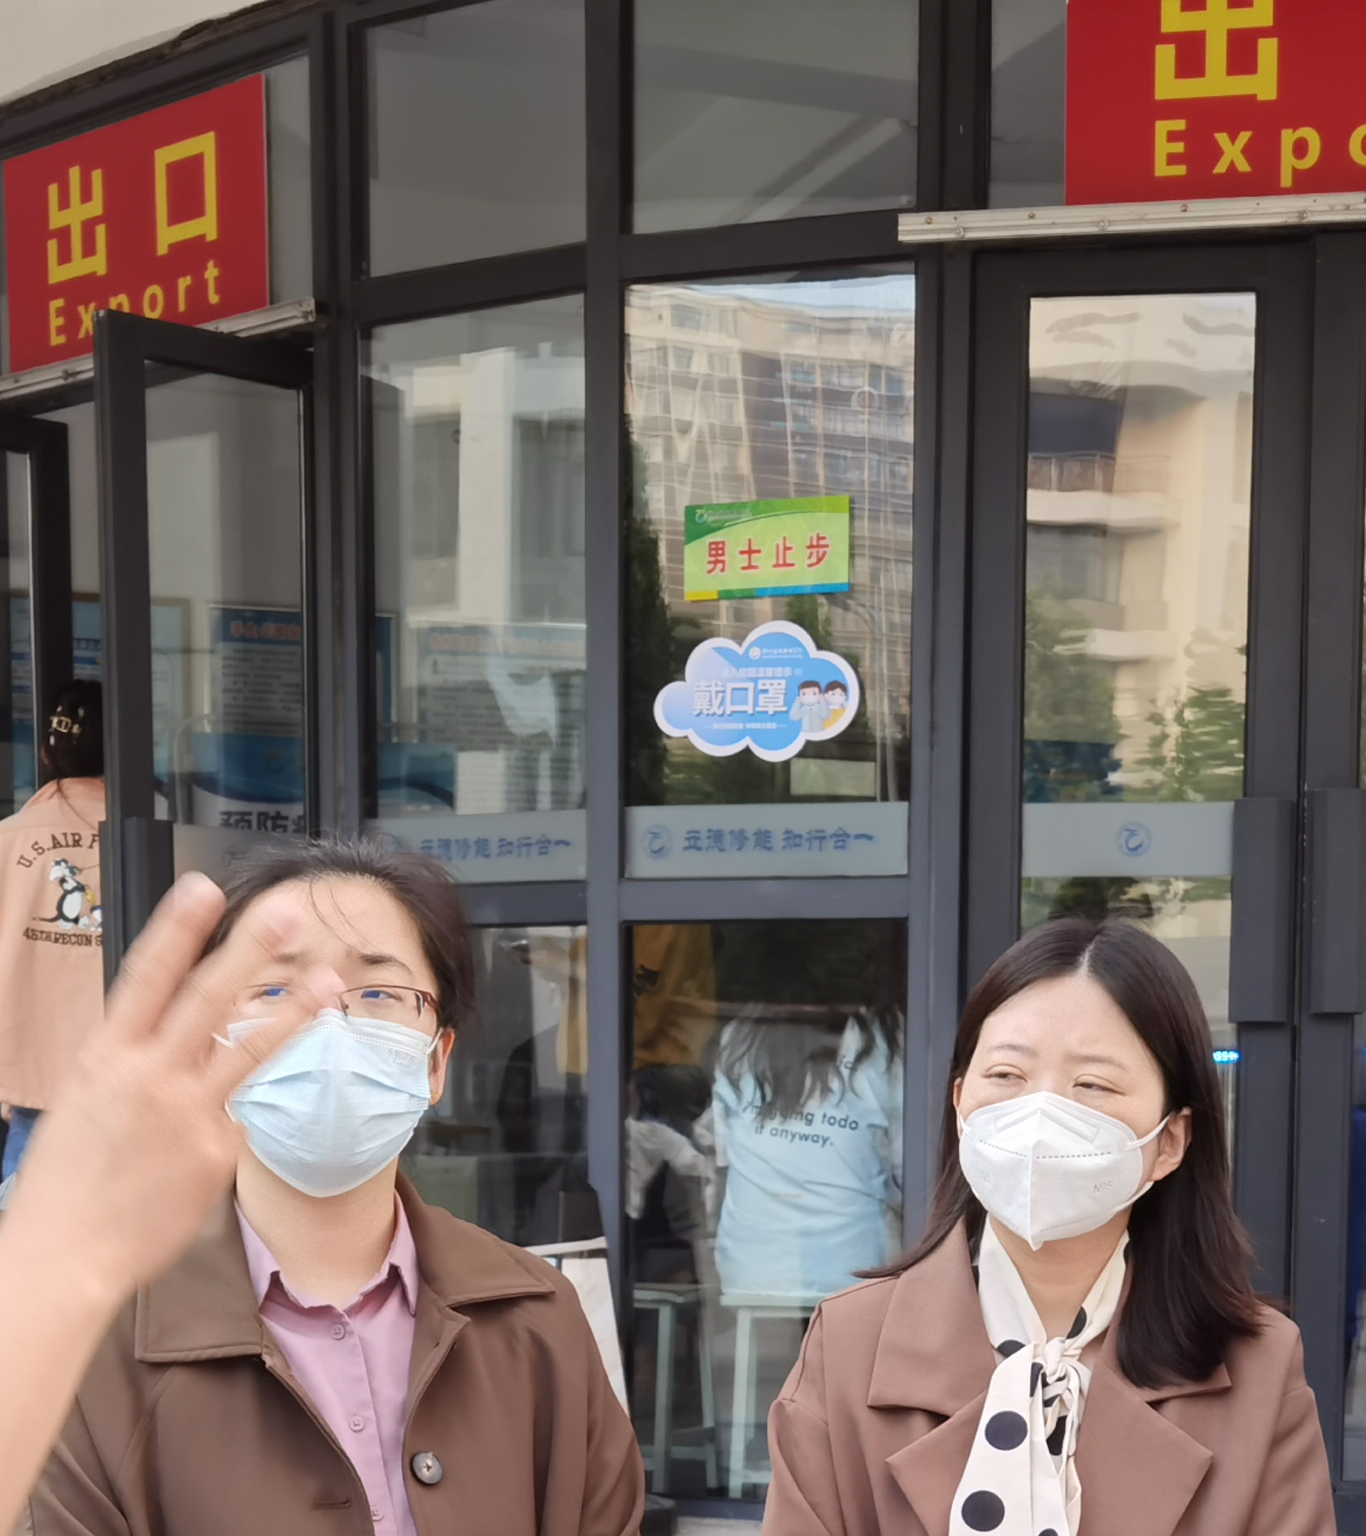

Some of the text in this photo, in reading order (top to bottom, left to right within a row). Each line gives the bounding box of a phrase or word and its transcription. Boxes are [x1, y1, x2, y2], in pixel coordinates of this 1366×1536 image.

[47, 131, 218, 285] 出口
[706, 532, 830, 575] 男士止步
[693, 680, 788, 717] 戴口罩
[769, 1127, 834, 1148] anyway.
